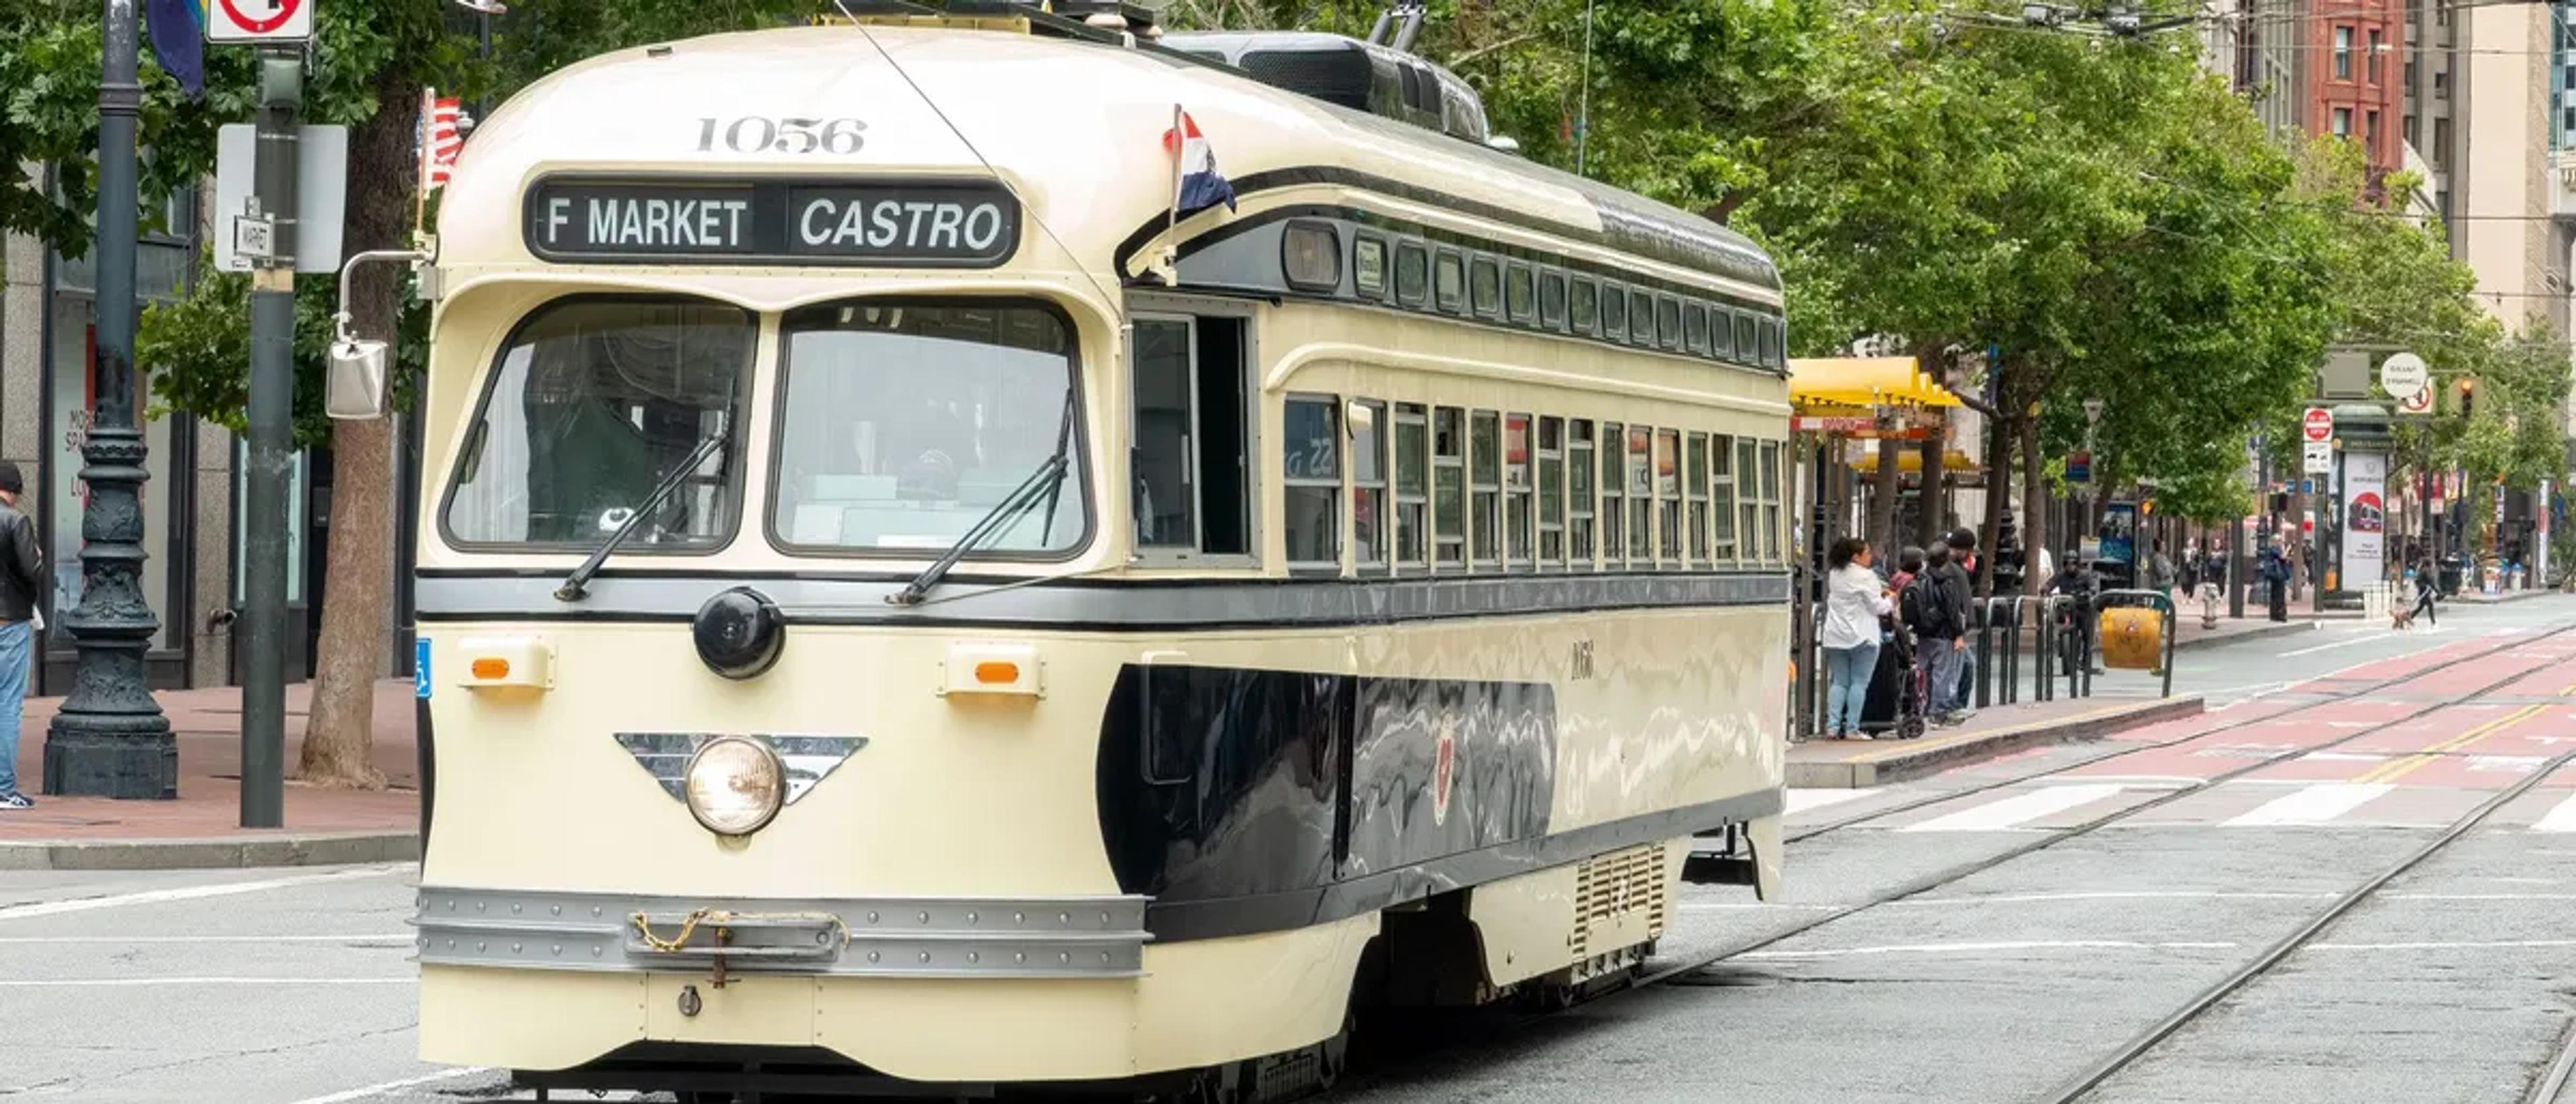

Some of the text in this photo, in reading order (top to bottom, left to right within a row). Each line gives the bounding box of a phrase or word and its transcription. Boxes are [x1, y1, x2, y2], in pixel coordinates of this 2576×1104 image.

[696, 115, 868, 154] 1056
[547, 198, 1002, 250] F MARKET CASTRO
